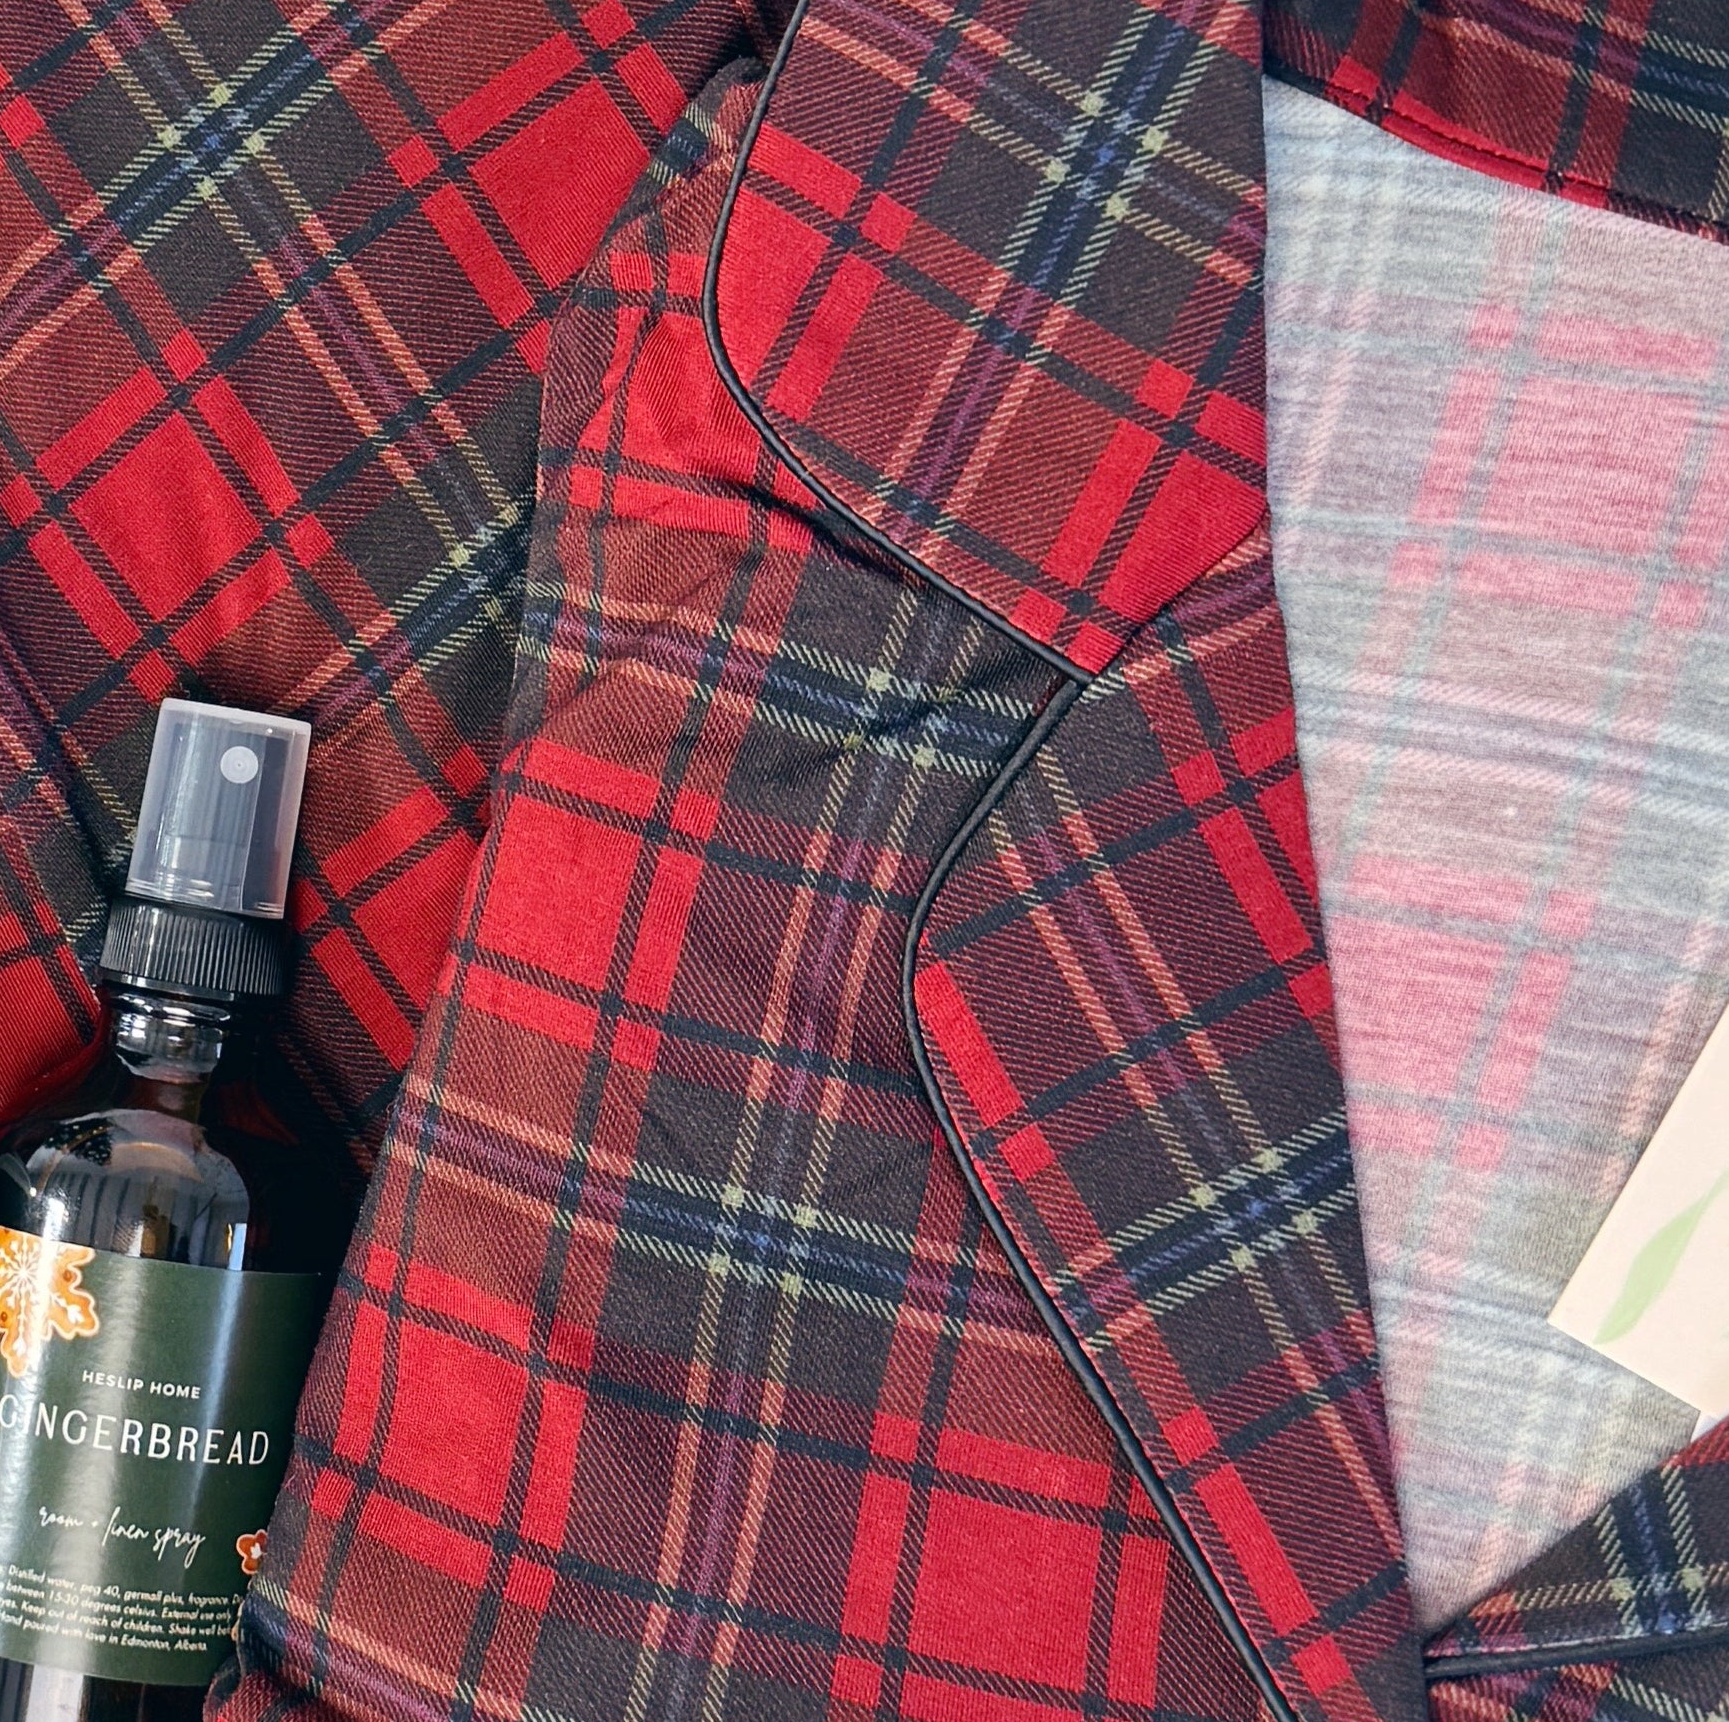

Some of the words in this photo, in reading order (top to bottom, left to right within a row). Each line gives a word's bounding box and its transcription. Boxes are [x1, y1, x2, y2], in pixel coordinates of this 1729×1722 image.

[81, 1369, 144, 1391] HESLIP
[149, 1380, 202, 1400] HOME
[38, 1505, 84, 1528] room
[101, 1505, 150, 1547] linen
[152, 1527, 207, 1569] spray
[8, 1564, 47, 1584] Distilled
[79, 1583, 102, 1597] peg
[102, 1584, 121, 1599] 40,
[5, 1579, 46, 1599] between
[49, 1589, 80, 1607] 15-30
[80, 1597, 122, 1613] degrees
[161, 1607, 200, 1621] External
[199, 1613, 215, 1621] use
[20, 1599, 47, 1618] Keep
[47, 1607, 65, 1620] out
[65, 1610, 79, 1622] of
[79, 1615, 109, 1627] reach
[110, 1616, 123, 1629] of
[168, 1622, 197, 1636] Shake
[198, 1623, 216, 1636] well
[22, 1618, 60, 1634] poured
[84, 1628, 108, 1643] love
[108, 1631, 120, 1645] in
